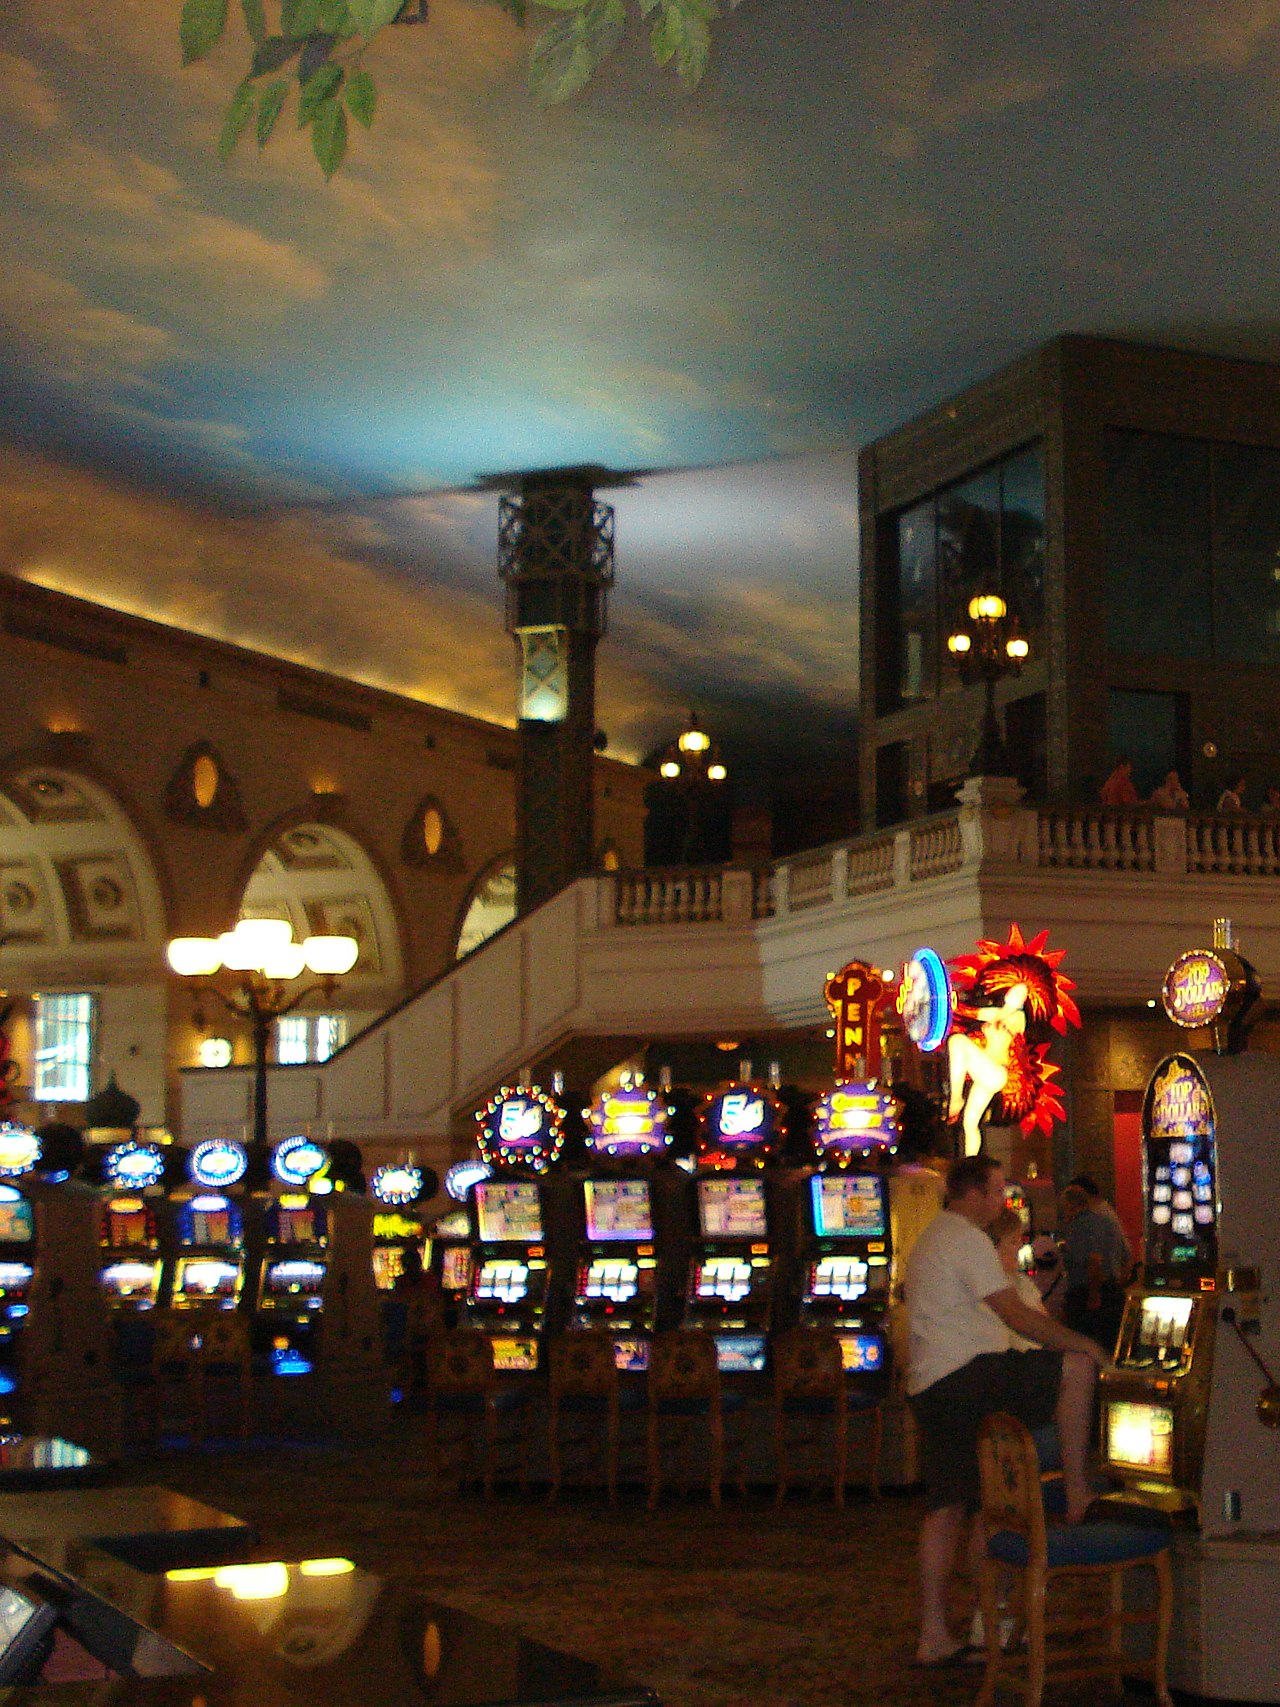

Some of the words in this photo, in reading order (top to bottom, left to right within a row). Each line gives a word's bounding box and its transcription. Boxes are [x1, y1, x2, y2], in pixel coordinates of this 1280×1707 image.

[1188, 963, 1210, 986] TOP
[1175, 981, 1223, 1010] DOLLAR
[1171, 1081, 1193, 1100] TOP
[1160, 1103, 1203, 1123] DOLLAR
